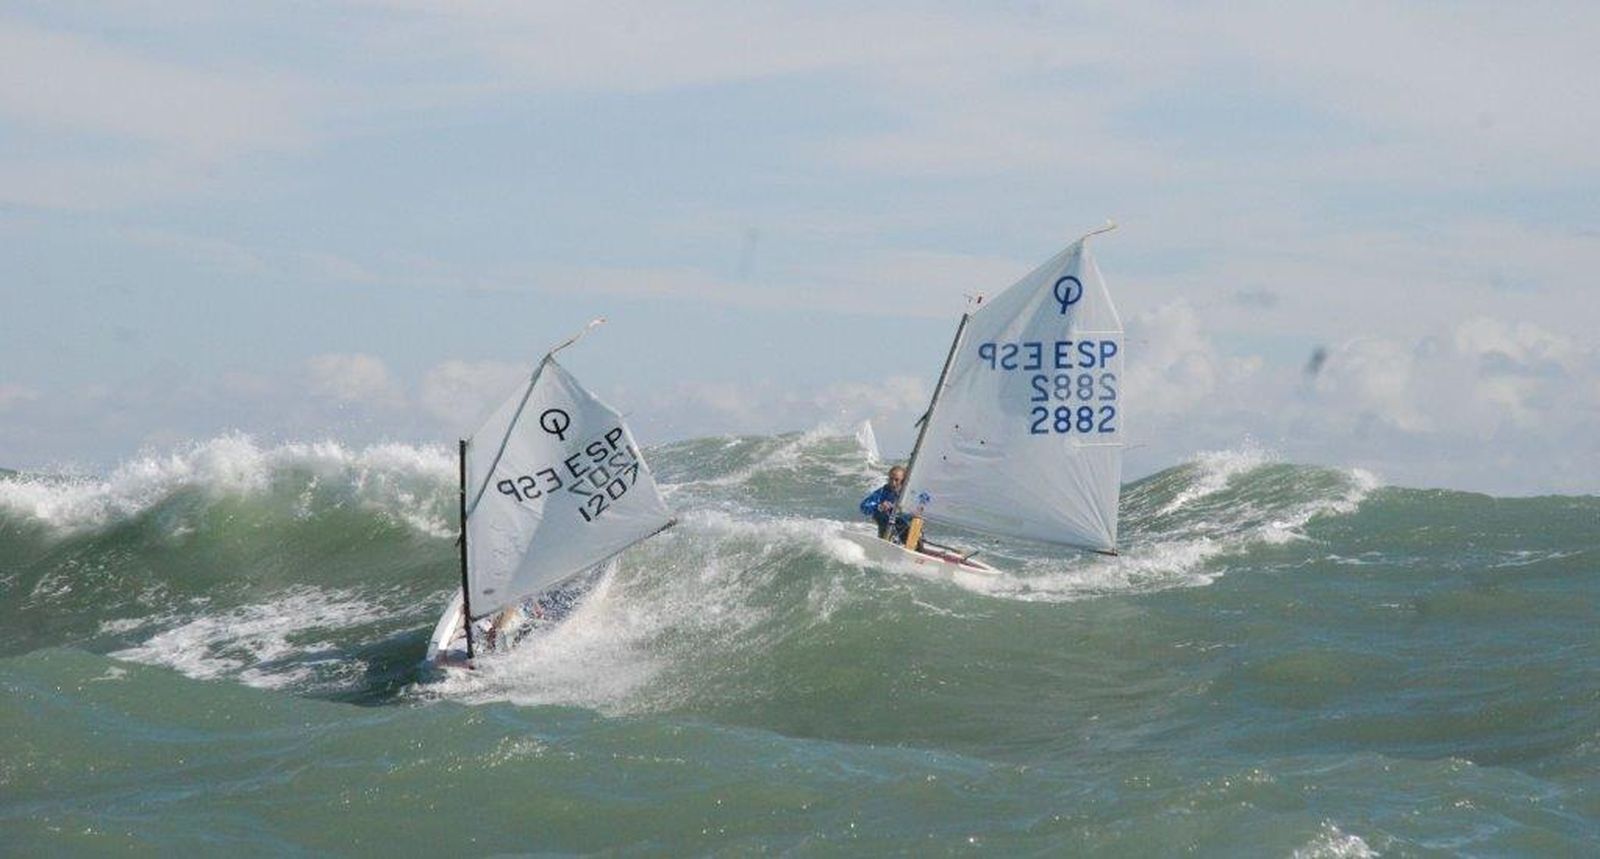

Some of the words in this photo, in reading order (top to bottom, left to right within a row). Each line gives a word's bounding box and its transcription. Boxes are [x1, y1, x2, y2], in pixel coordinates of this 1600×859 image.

[1054, 340, 1118, 369] ESP
[1031, 406, 1115, 434] 2882
[564, 427, 623, 478] ESP
[578, 461, 639, 522] 1207
